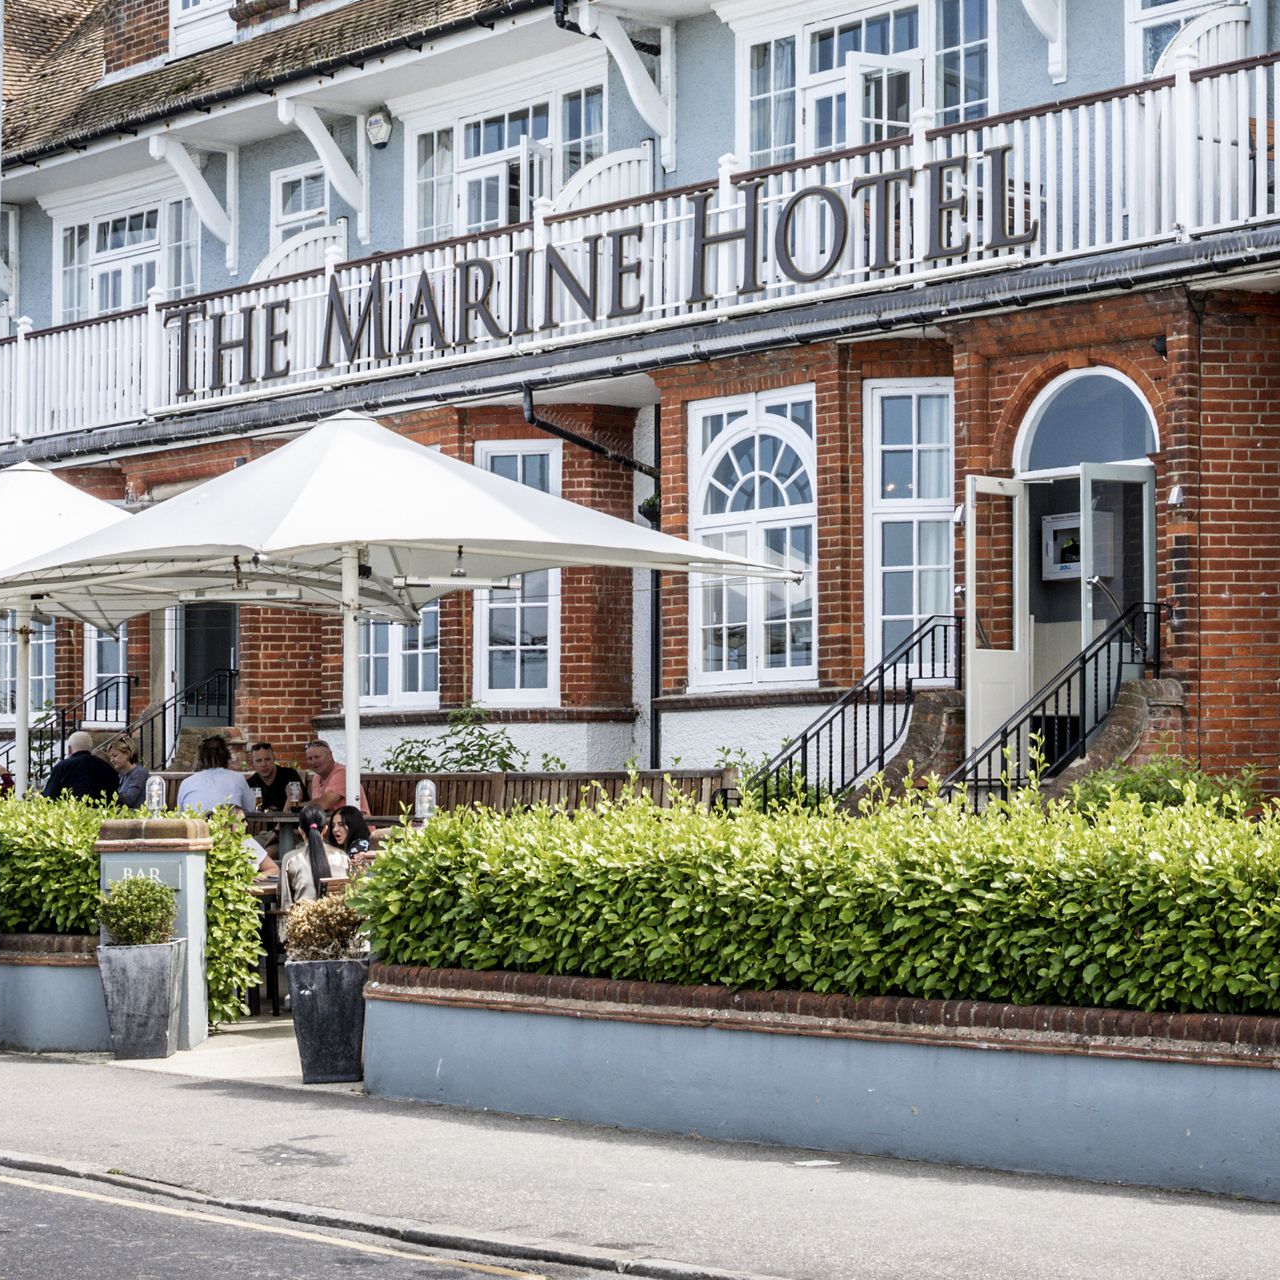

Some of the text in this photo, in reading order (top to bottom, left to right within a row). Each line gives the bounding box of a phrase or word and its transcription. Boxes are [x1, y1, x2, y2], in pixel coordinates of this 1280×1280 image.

[163, 144, 1039, 397] THE MARINE HOTEL
[122, 867, 164, 884] BAR
